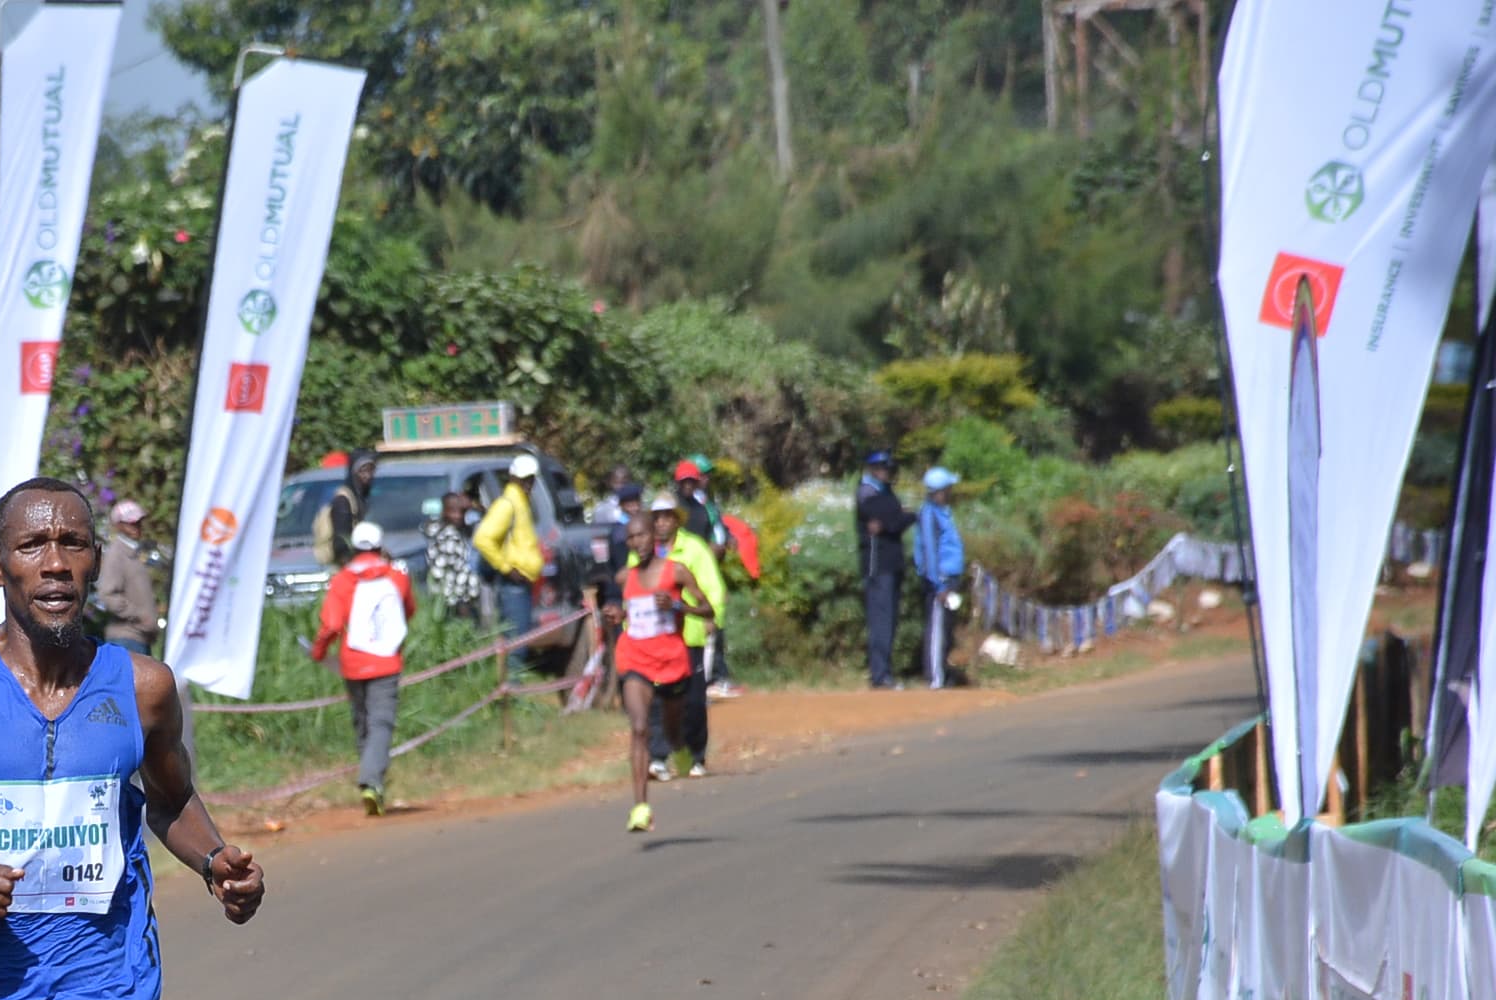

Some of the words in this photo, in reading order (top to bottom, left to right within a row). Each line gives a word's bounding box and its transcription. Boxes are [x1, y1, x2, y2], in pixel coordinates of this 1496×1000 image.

[1343, 0, 1417, 151] OLDMUT
[1366, 260, 1404, 352] INSURANCE
[1444, 45, 1481, 118] SAVINGS
[62, 863, 104, 882] 0142
